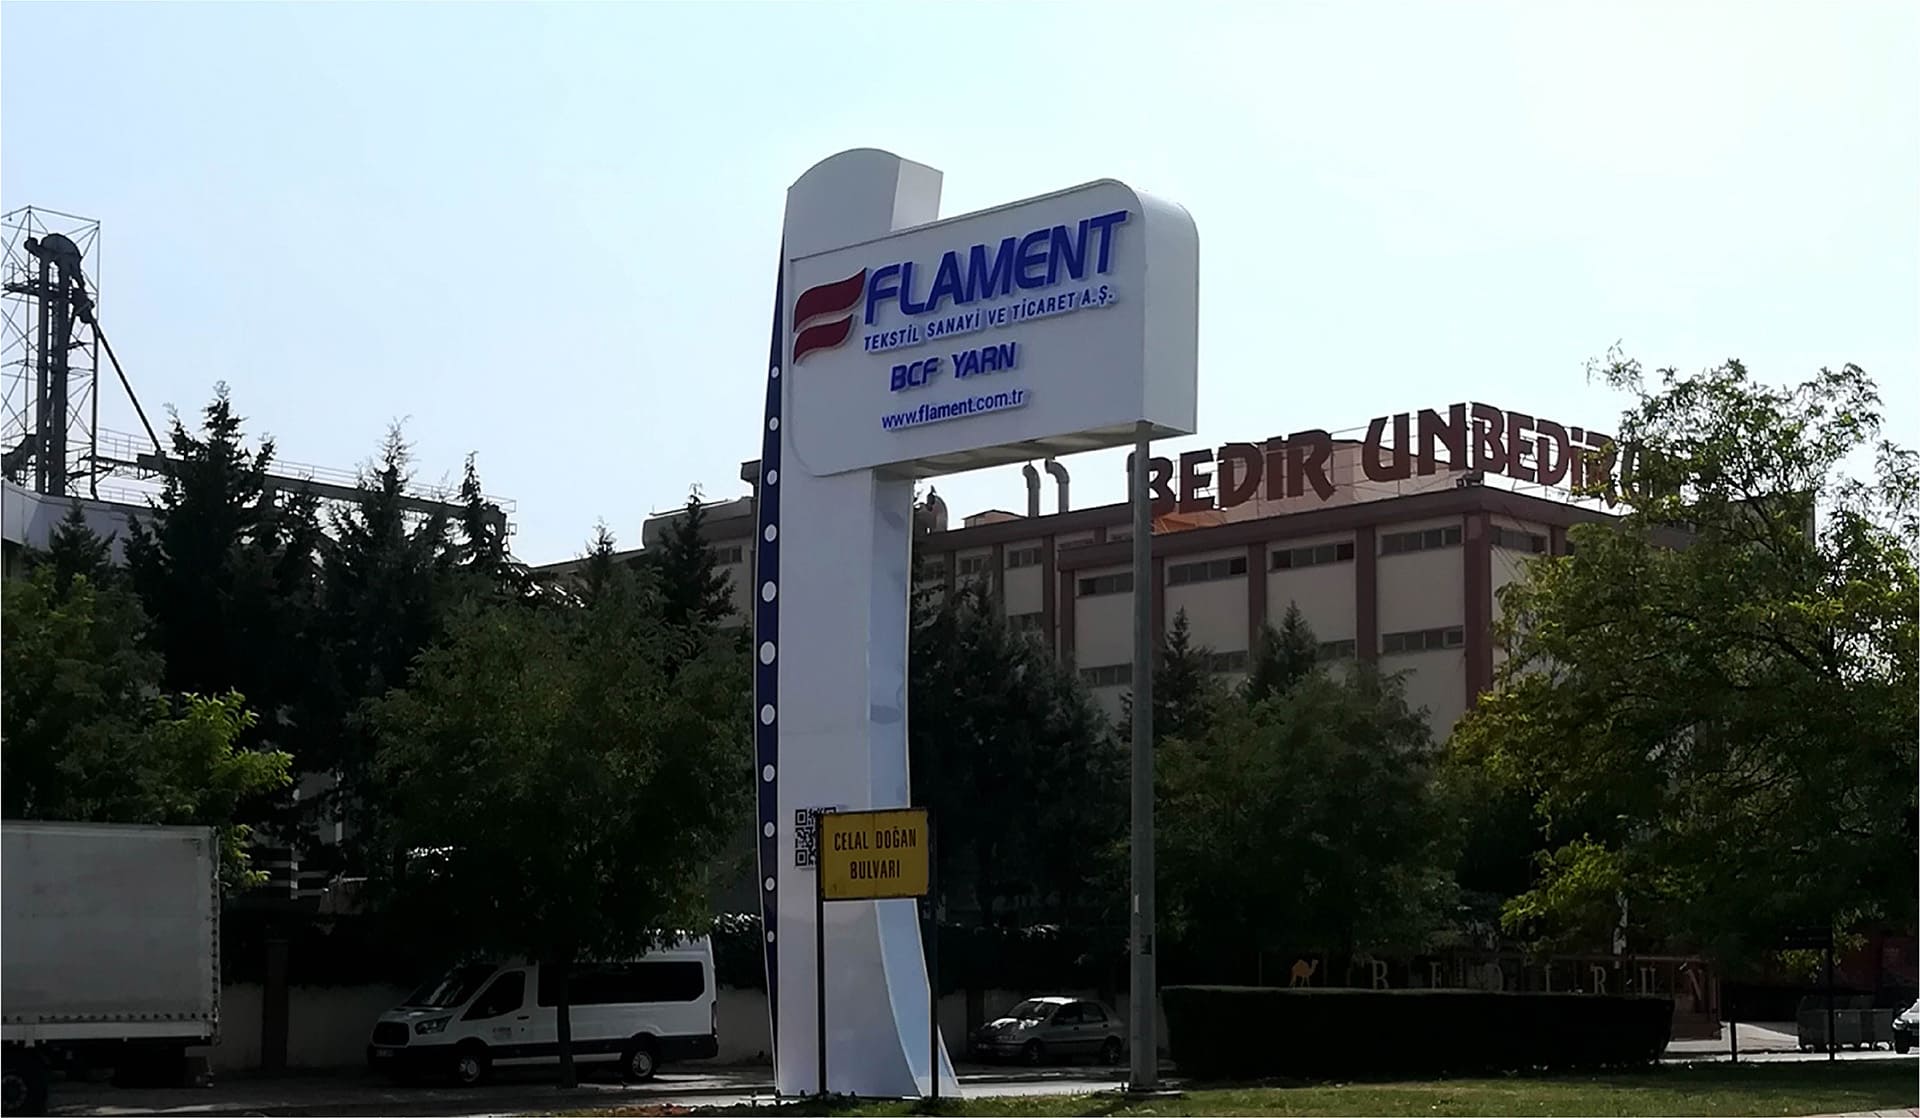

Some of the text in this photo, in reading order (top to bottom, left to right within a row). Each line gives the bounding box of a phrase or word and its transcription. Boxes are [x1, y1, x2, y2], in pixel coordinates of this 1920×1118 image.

[864, 210, 1128, 325] FLAMENT
[864, 284, 1113, 351] TEKSTİL SANAYİ VE TİCARET A.Ş.
[890, 341, 1017, 392] BCF YARN
[881, 389, 1024, 430] www.flament.com.tr
[1362, 402, 1467, 482] UN
[834, 825, 917, 851] CELAL DOĞAN
[849, 859, 900, 880] BULVARI
